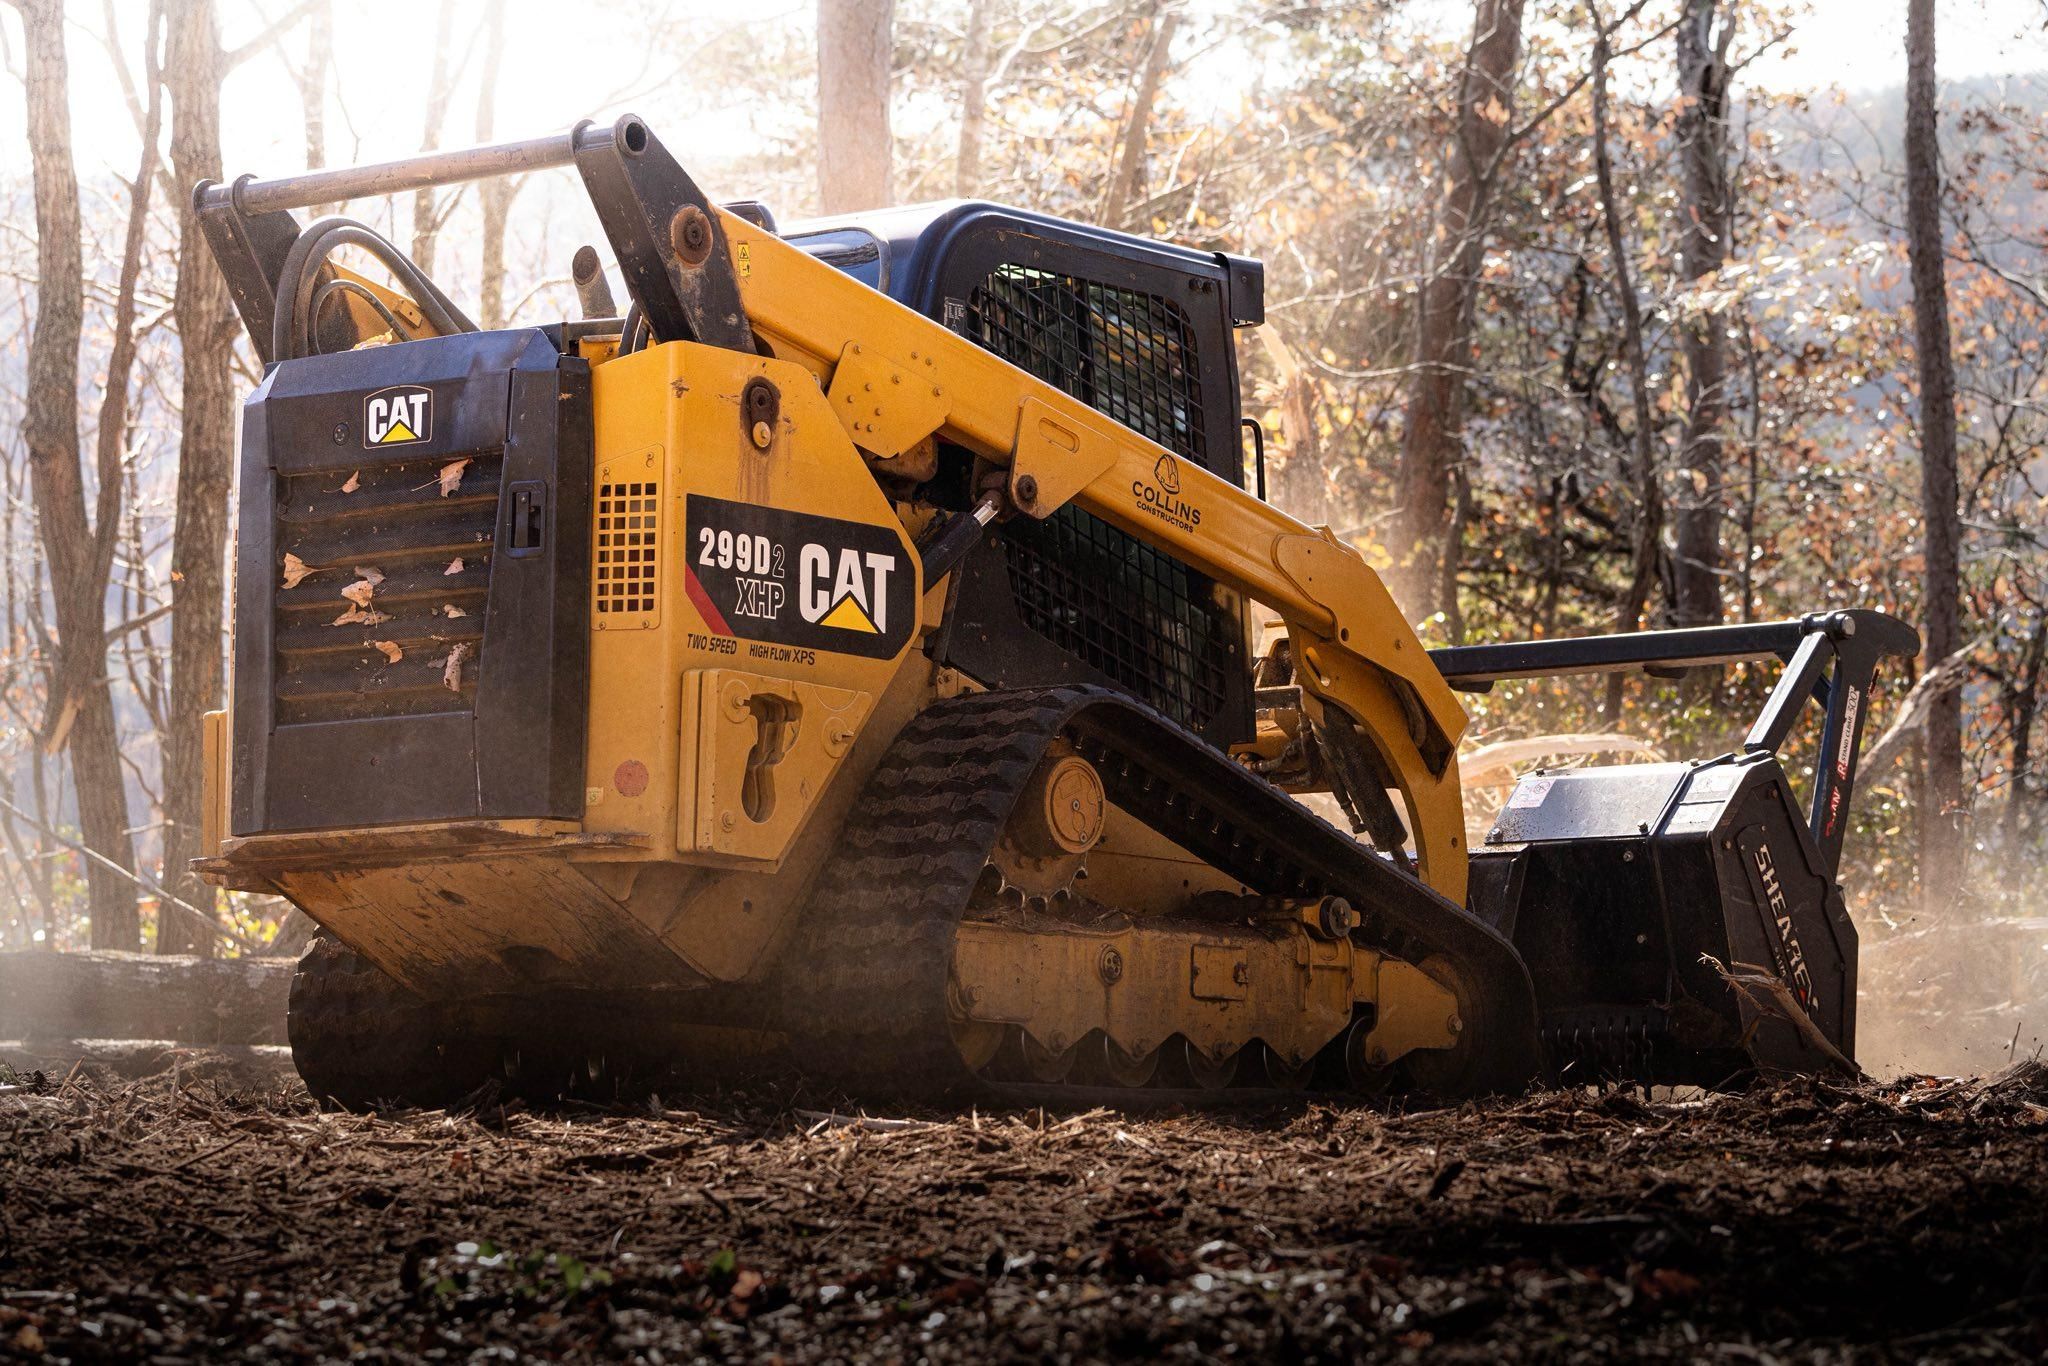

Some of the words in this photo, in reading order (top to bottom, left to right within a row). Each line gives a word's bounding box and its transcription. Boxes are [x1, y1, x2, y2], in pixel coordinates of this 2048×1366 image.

[368, 393, 428, 443] CAT
[1132, 481, 1201, 525] COLLINS
[1136, 501, 1194, 533] CONSTRUCTORS
[735, 577, 785, 620] XHP
[799, 543, 895, 634] CAT
[687, 634, 707, 650] TWO
[709, 637, 737, 655] SPEED
[749, 644, 769, 660] HIGH
[769, 647, 792, 663] FLOW
[792, 648, 816, 666] XPS
[1841, 738, 1849, 760] STAND
